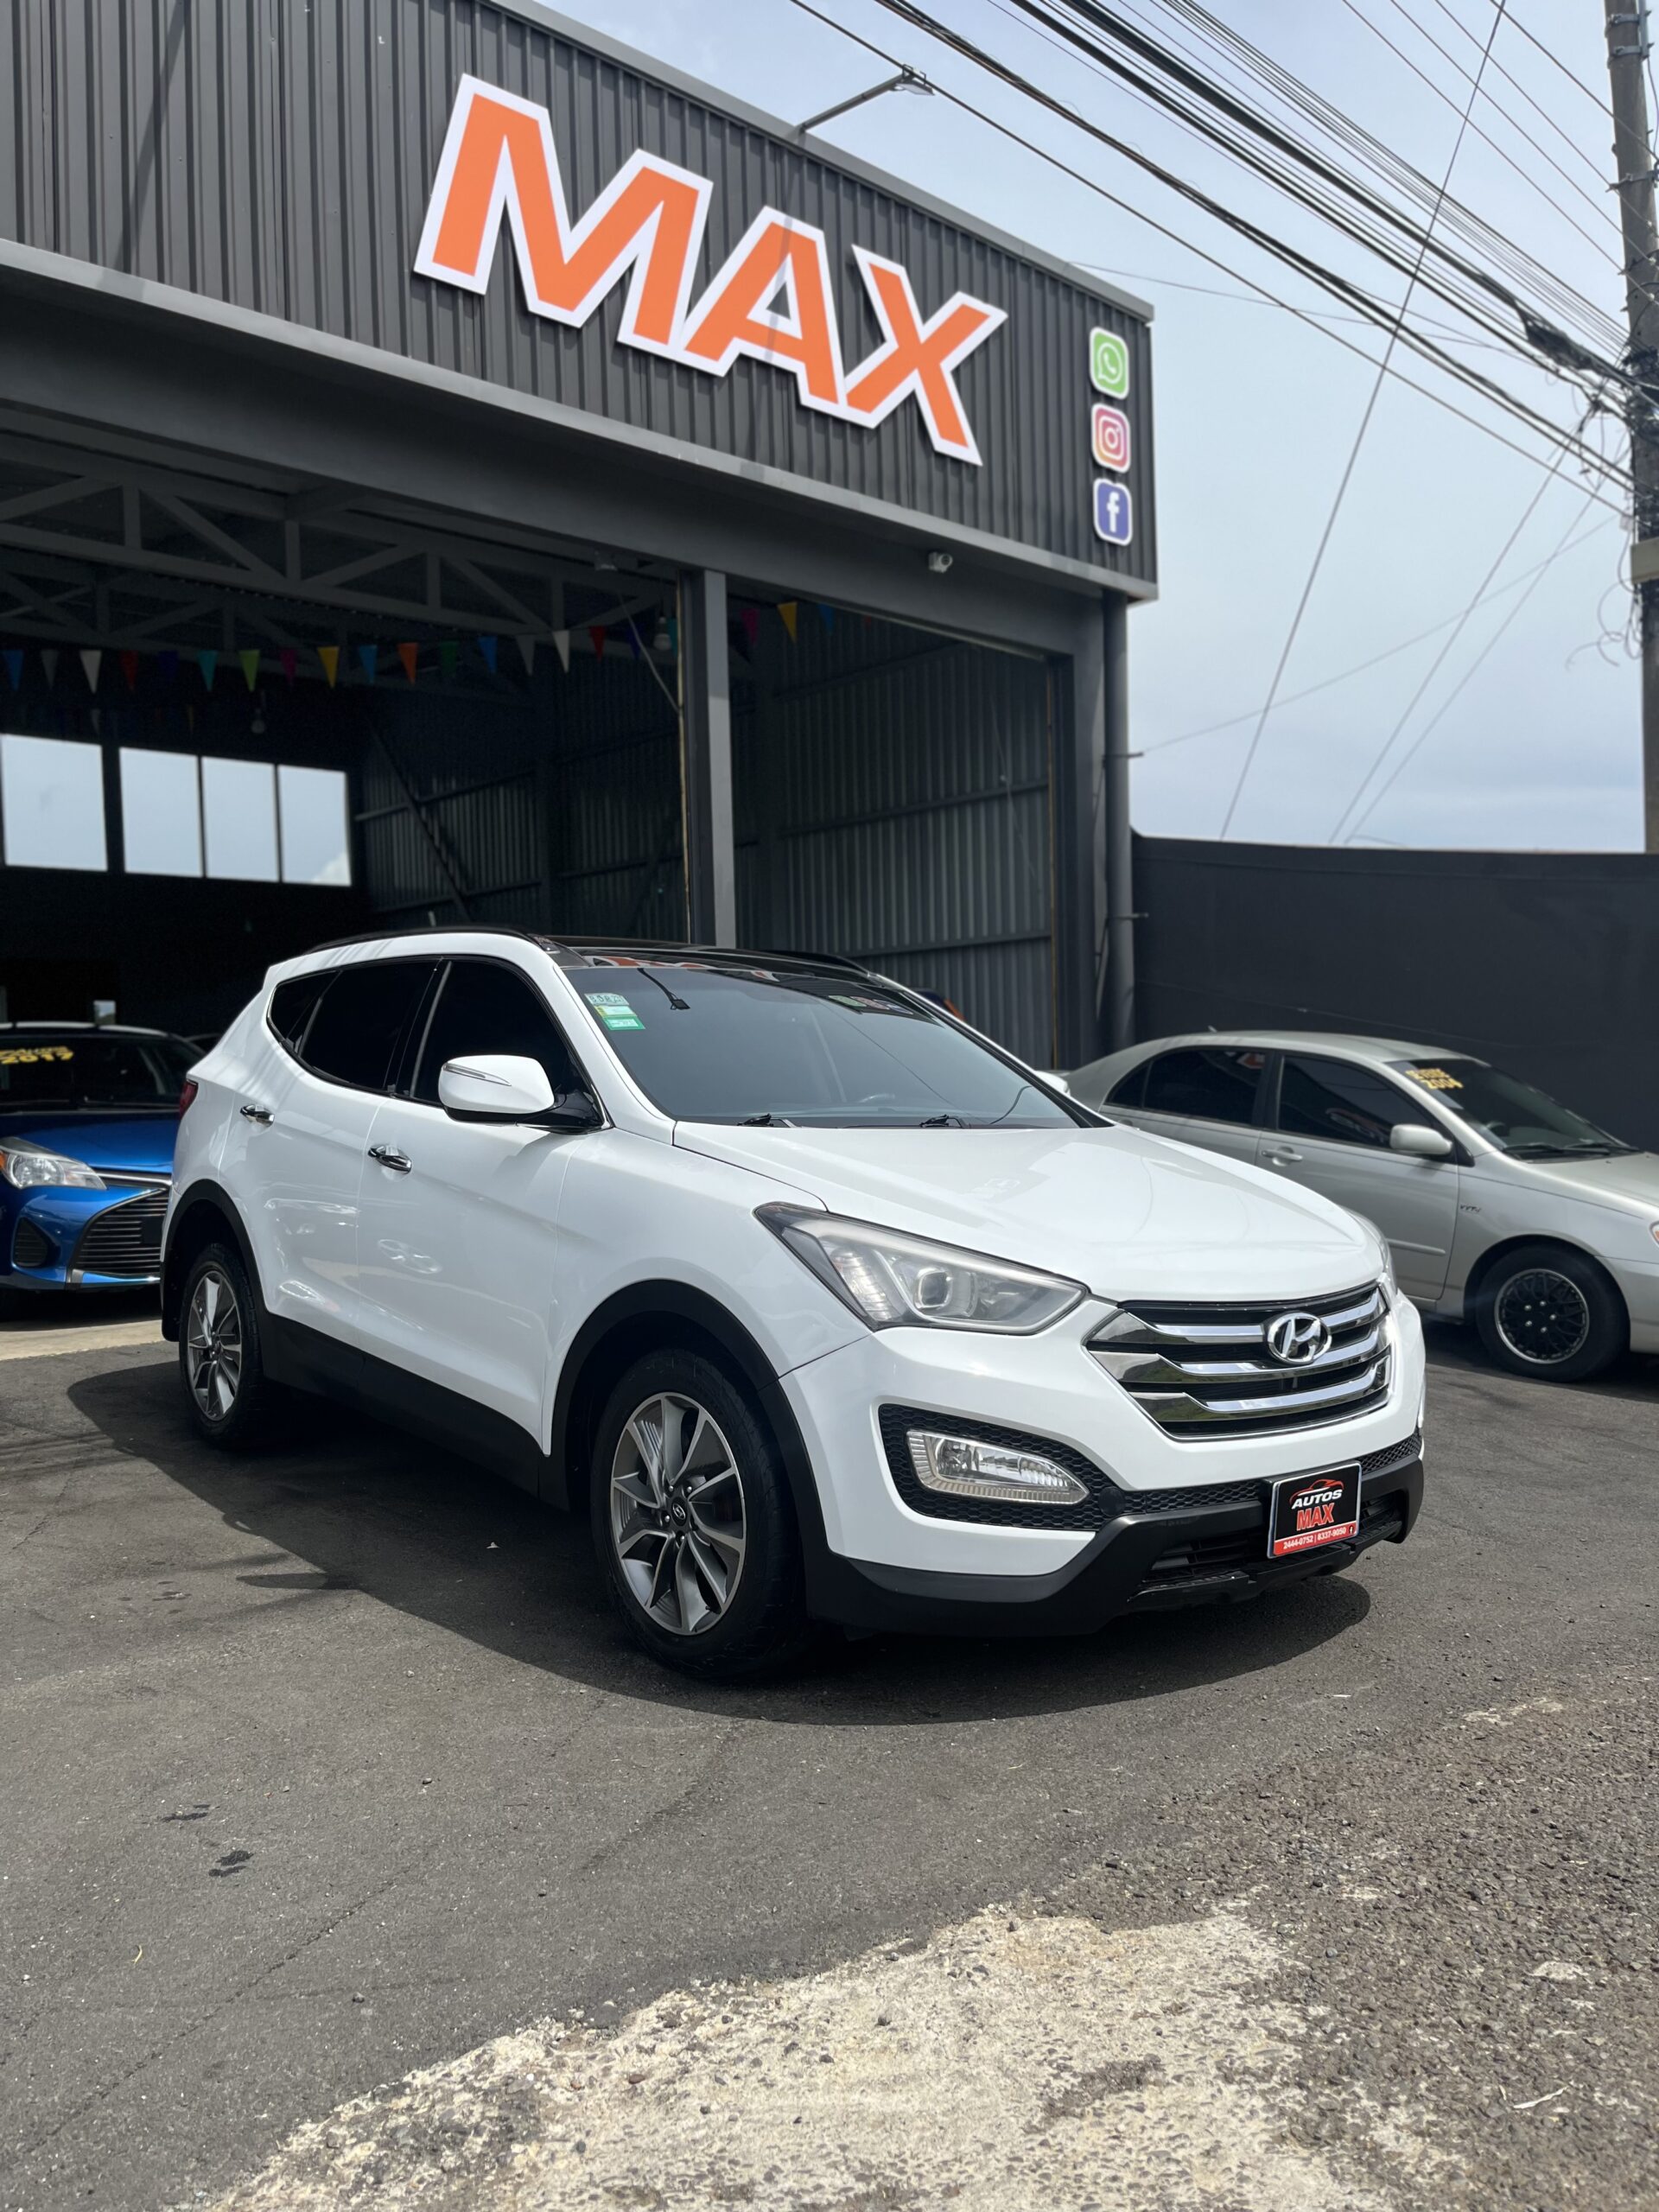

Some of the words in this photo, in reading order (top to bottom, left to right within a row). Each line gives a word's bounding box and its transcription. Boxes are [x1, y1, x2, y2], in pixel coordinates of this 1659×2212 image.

[414, 73, 1007, 466] MAX
[1291, 1489, 1343, 1510] AUTOS
[1296, 1502, 1335, 1531] MAX
